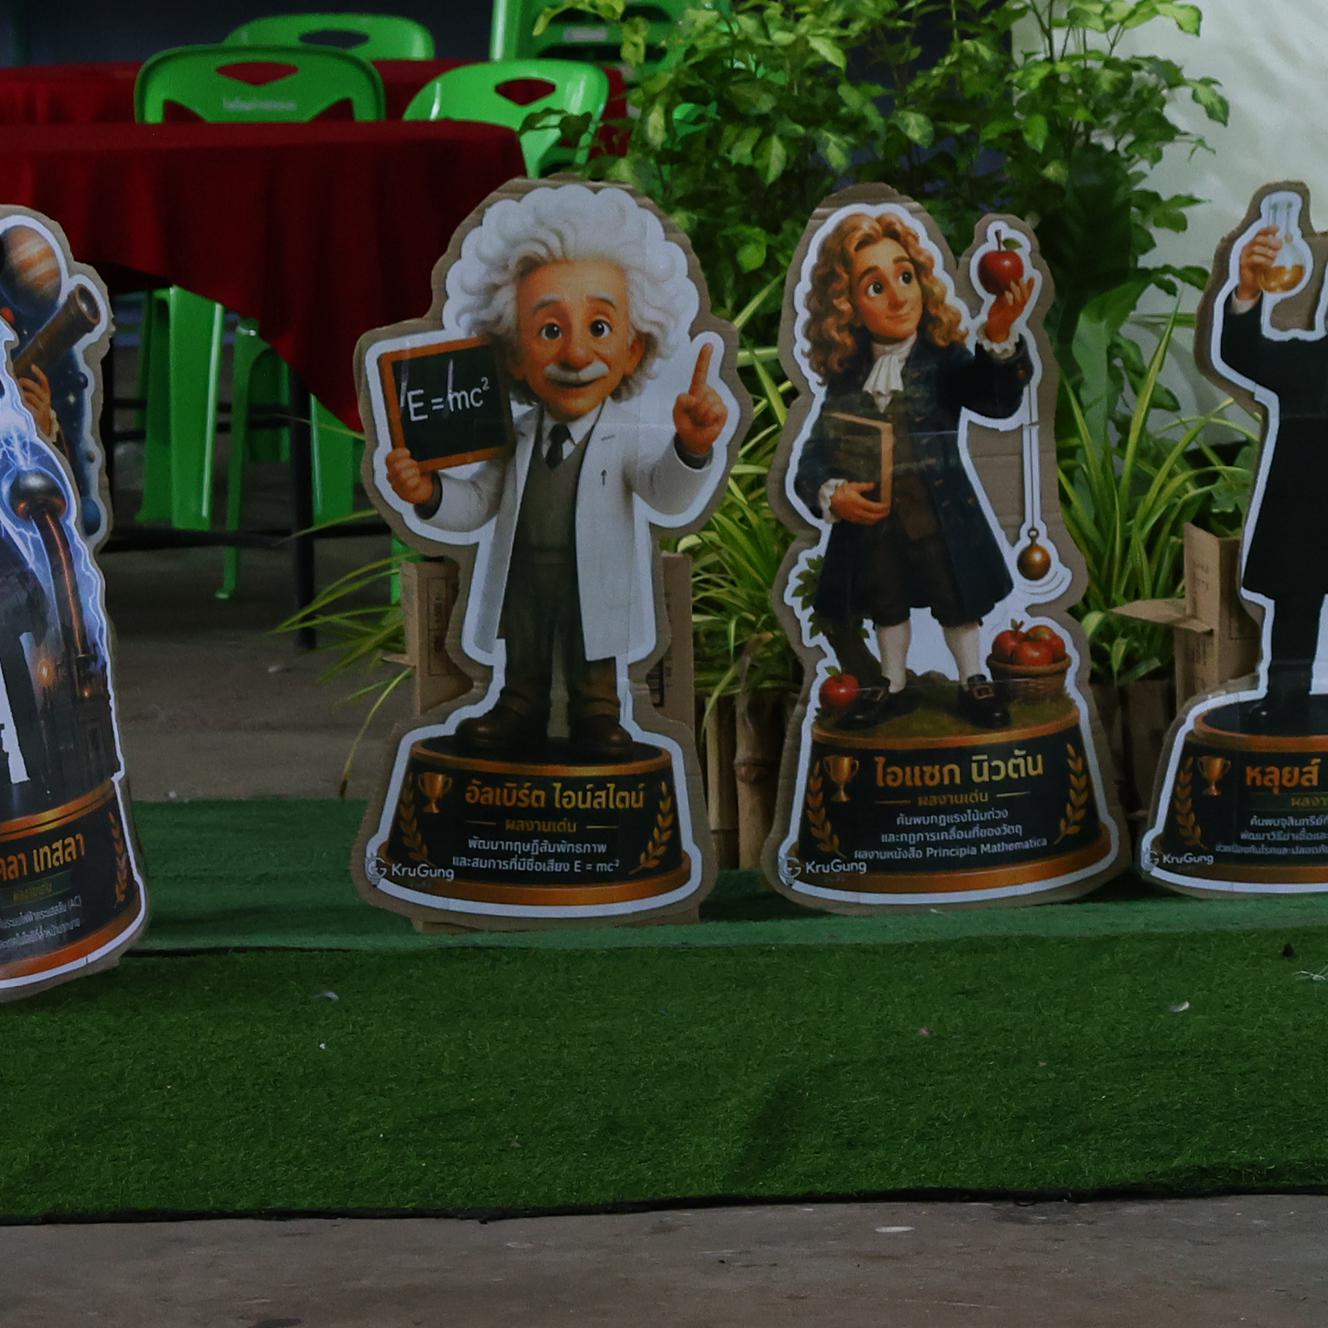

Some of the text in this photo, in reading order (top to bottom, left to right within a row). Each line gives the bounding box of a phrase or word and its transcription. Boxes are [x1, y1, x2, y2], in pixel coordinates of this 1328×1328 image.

[874, 748, 1044, 788] ไอแซก นิวตัน
[1245, 759, 1322, 795] หลุยส์
[554, 781, 646, 810] ไอน์สไตน์
[926, 845, 978, 861] Principia
[980, 837, 1048, 855] Mathematica
[1162, 852, 1214, 867] KruGung
[392, 862, 455, 881] KruGung
[806, 858, 867, 874] KruGung
